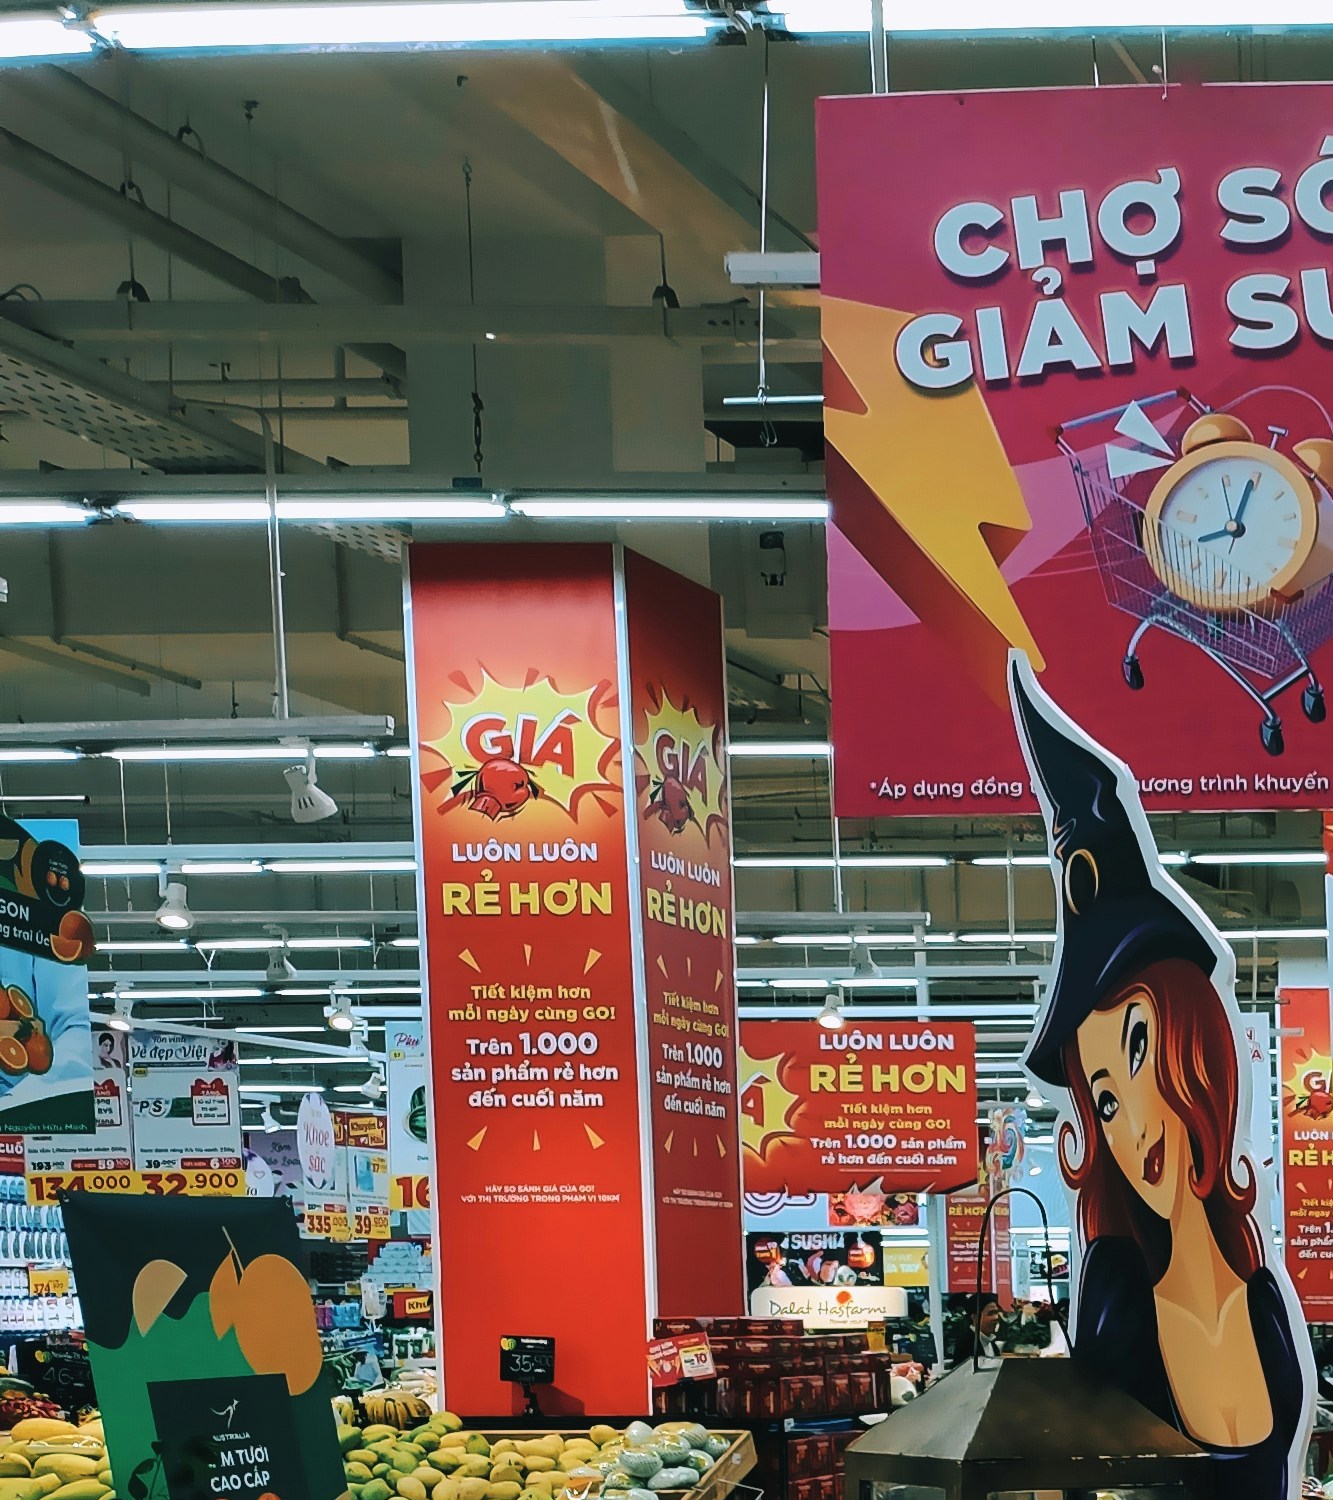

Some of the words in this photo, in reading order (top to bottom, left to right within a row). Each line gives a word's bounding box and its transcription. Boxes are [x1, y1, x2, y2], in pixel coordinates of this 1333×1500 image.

[933, 166, 1182, 276] CHỢ
[895, 266, 1196, 389] GIẢM
[912, 779, 964, 801] dụng
[970, 775, 1023, 798] đồng
[1199, 771, 1249, 792] trình
[1254, 771, 1330, 794] khuyến
[452, 838, 522, 863] LUÔN
[529, 838, 598, 862] LUÔN
[441, 868, 503, 917] RẺ
[509, 878, 613, 917] HƠN
[646, 879, 677, 926] RẺ
[678, 898, 728, 940] HƠN
[470, 984, 507, 1000] Tiết
[510, 984, 553, 1004] kiệm
[557, 984, 592, 1000] hơn
[448, 1005, 482, 1021] mỗi
[486, 1006, 530, 1023] ngày
[534, 1004, 578, 1023] cùng
[582, 1005, 617, 1021] GO!
[465, 1038, 514, 1057] Trên
[518, 1031, 599, 1057] 1.000
[819, 1029, 883, 1052] LUÔN
[889, 1029, 955, 1051] LUÔN
[685, 1041, 724, 1070] 1.000
[451, 1062, 487, 1082] sản
[490, 1059, 549, 1083] phẩm
[553, 1062, 575, 1081] rẻ
[579, 1064, 619, 1081] hơn
[809, 1052, 865, 1095] RẺ
[872, 1060, 967, 1095] HƠN
[467, 1088, 507, 1108] đến
[511, 1088, 555, 1108] cuối
[559, 1090, 604, 1108] năm
[844, 1133, 898, 1151] 1.000
[1288, 1142, 1319, 1167] RẺ
[769, 1299, 812, 1316] Dalat
[210, 1473, 242, 1493] CAO
[244, 1464, 271, 1488] CẤP
